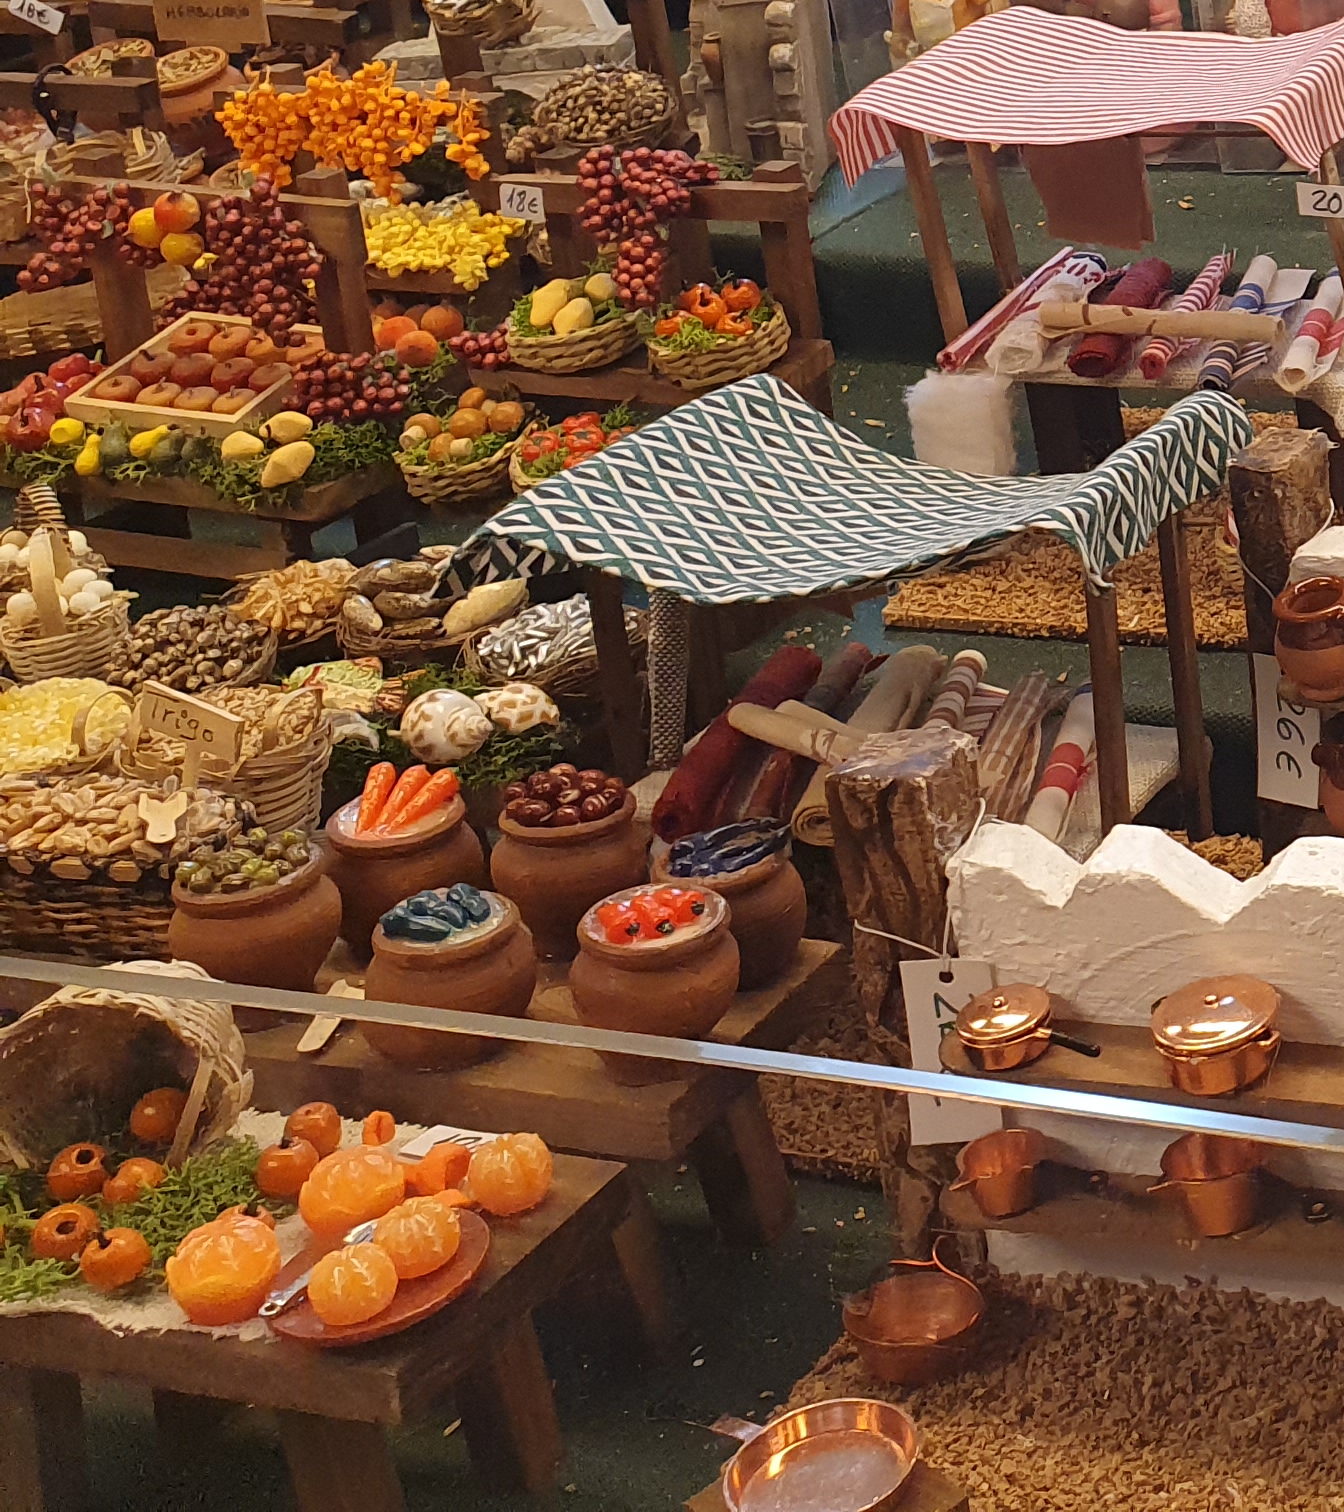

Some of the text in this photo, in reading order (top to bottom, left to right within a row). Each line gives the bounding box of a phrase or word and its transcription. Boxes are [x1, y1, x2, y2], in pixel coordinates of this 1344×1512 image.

[15, 0, 51, 25] 18€
[506, 186, 539, 215] 18€
[146, 690, 214, 743] Trigo
